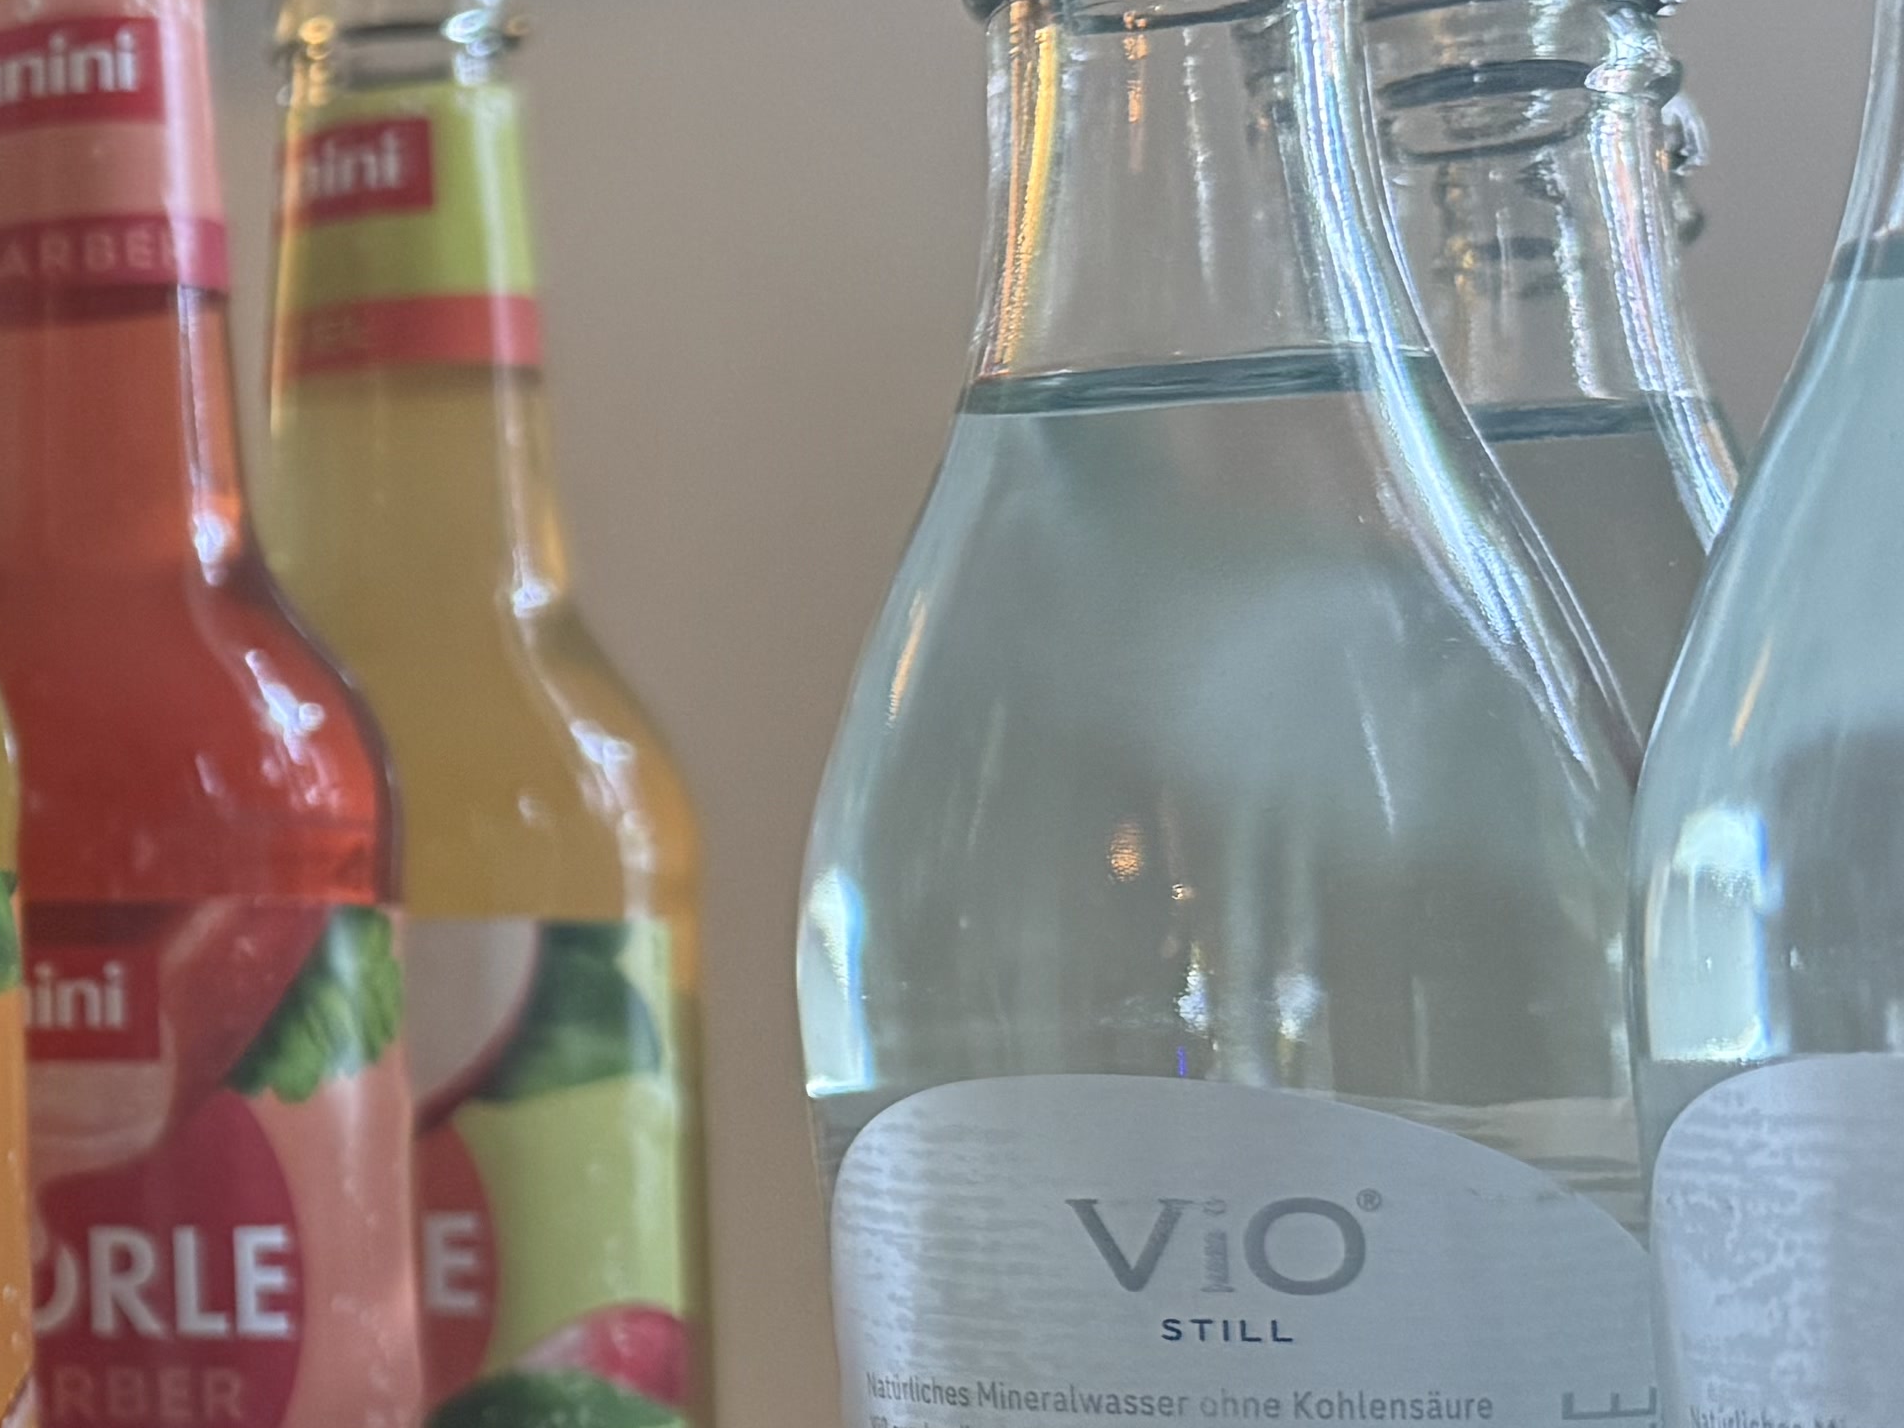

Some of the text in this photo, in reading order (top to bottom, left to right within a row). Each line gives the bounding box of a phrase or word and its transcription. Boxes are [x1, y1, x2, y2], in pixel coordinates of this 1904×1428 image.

[1161, 1318, 1294, 1342] STILL
[866, 1371, 1494, 1421] Natürliches Mineralwasser ohne Kohlensäure
